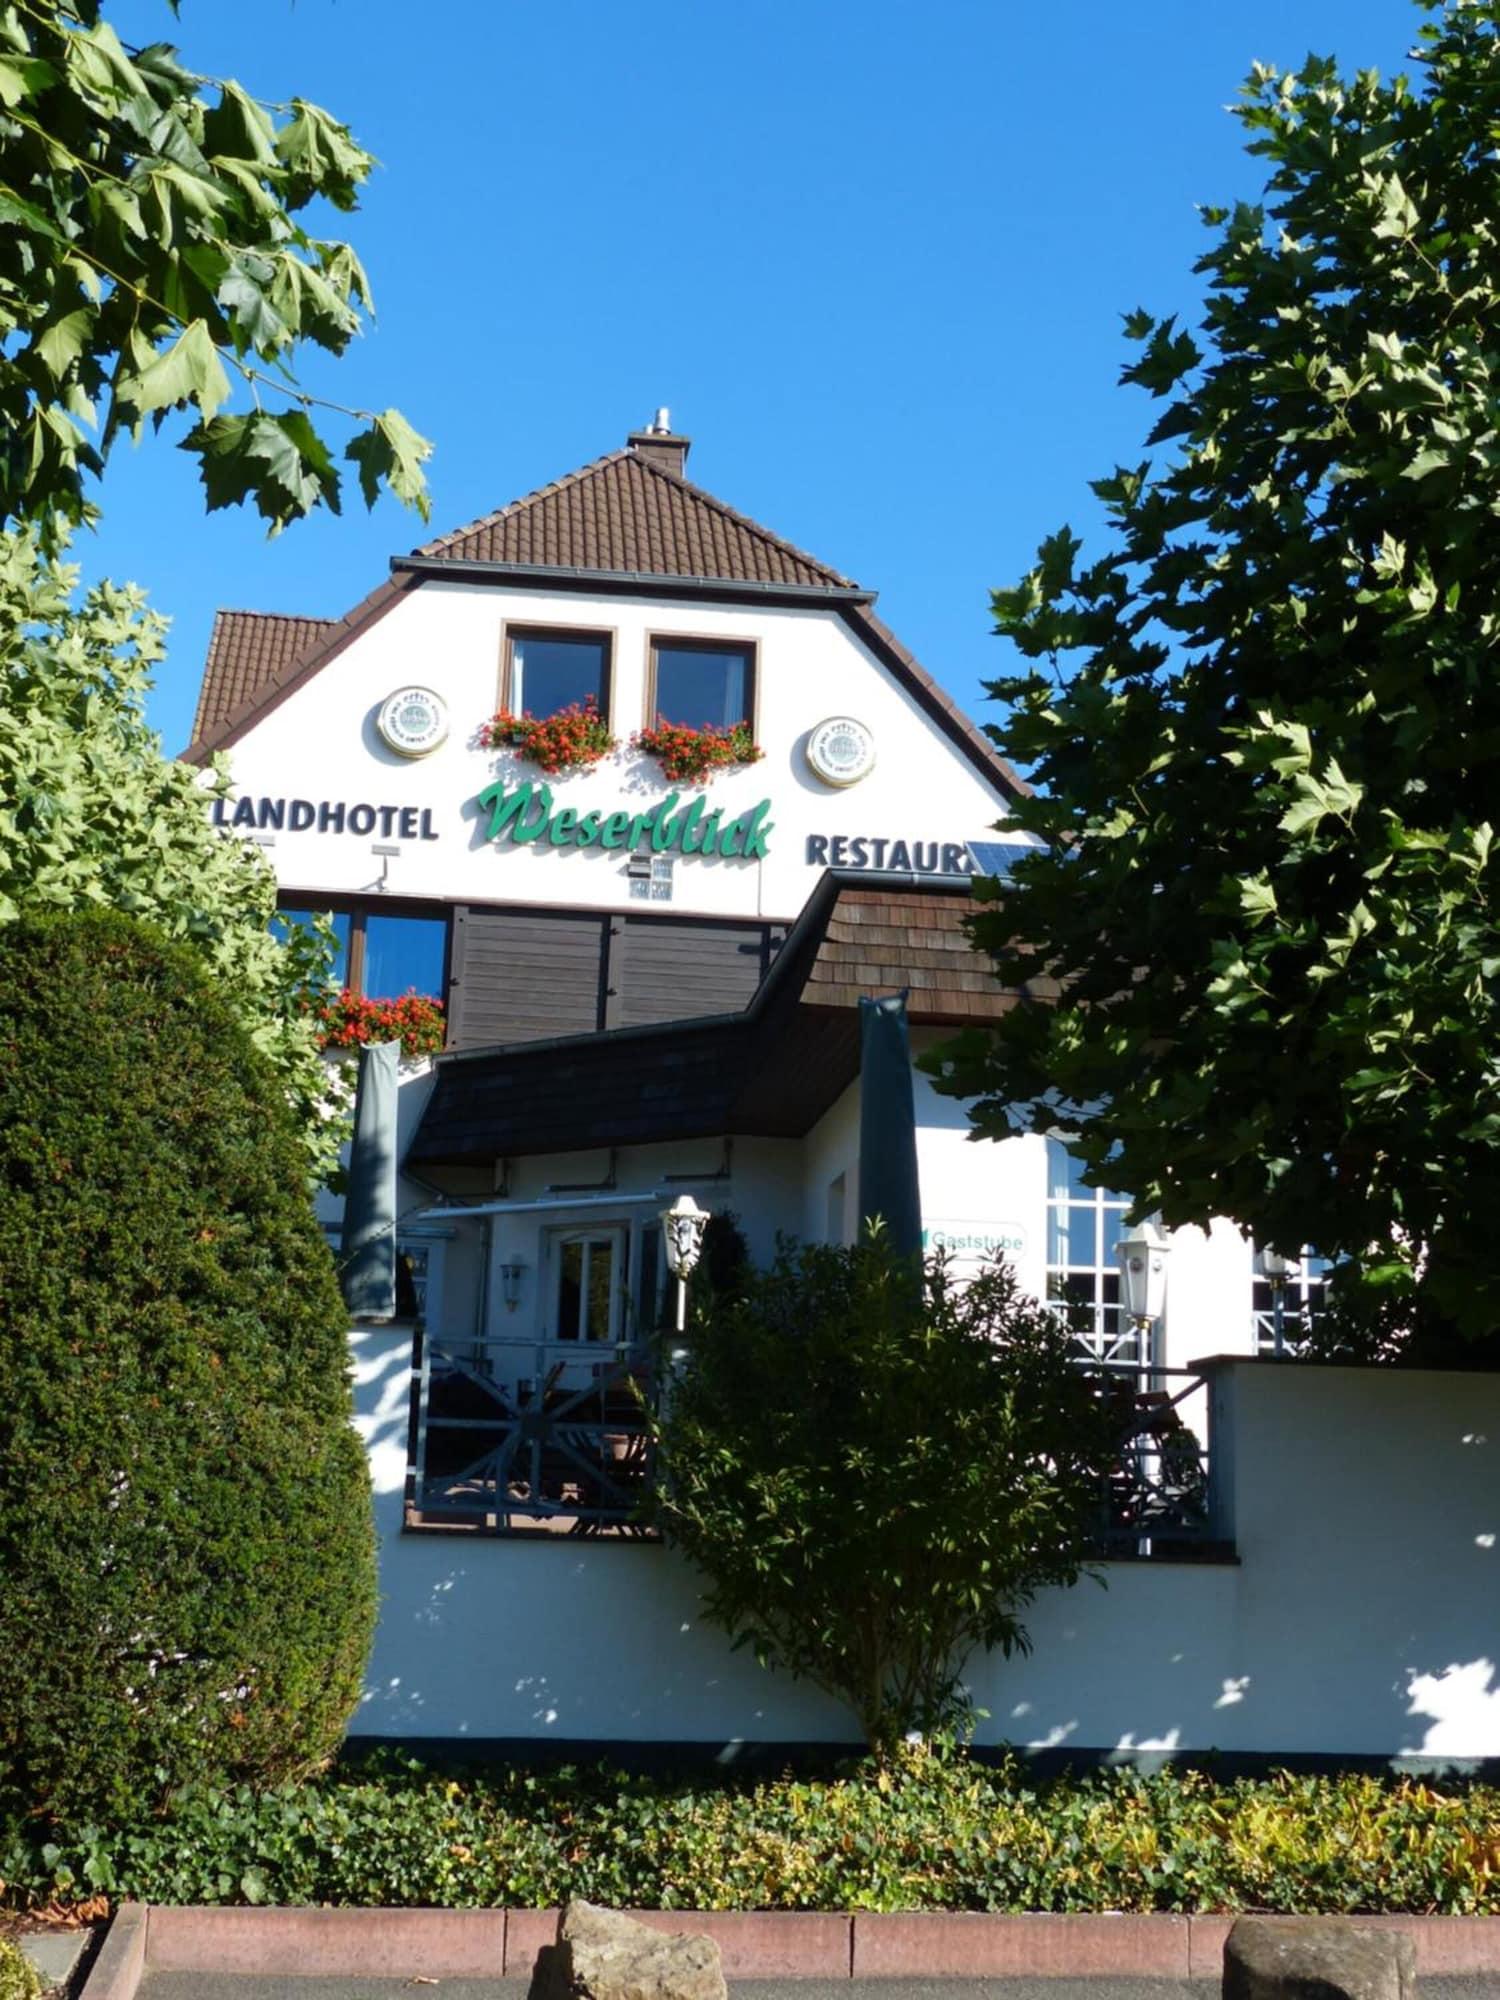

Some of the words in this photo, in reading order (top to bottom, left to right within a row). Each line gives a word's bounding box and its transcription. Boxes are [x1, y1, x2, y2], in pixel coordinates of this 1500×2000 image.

[212, 796, 439, 841] LANDHOTEL
[478, 780, 775, 859] Weserblick
[931, 1231, 1024, 1250] Gaststube
